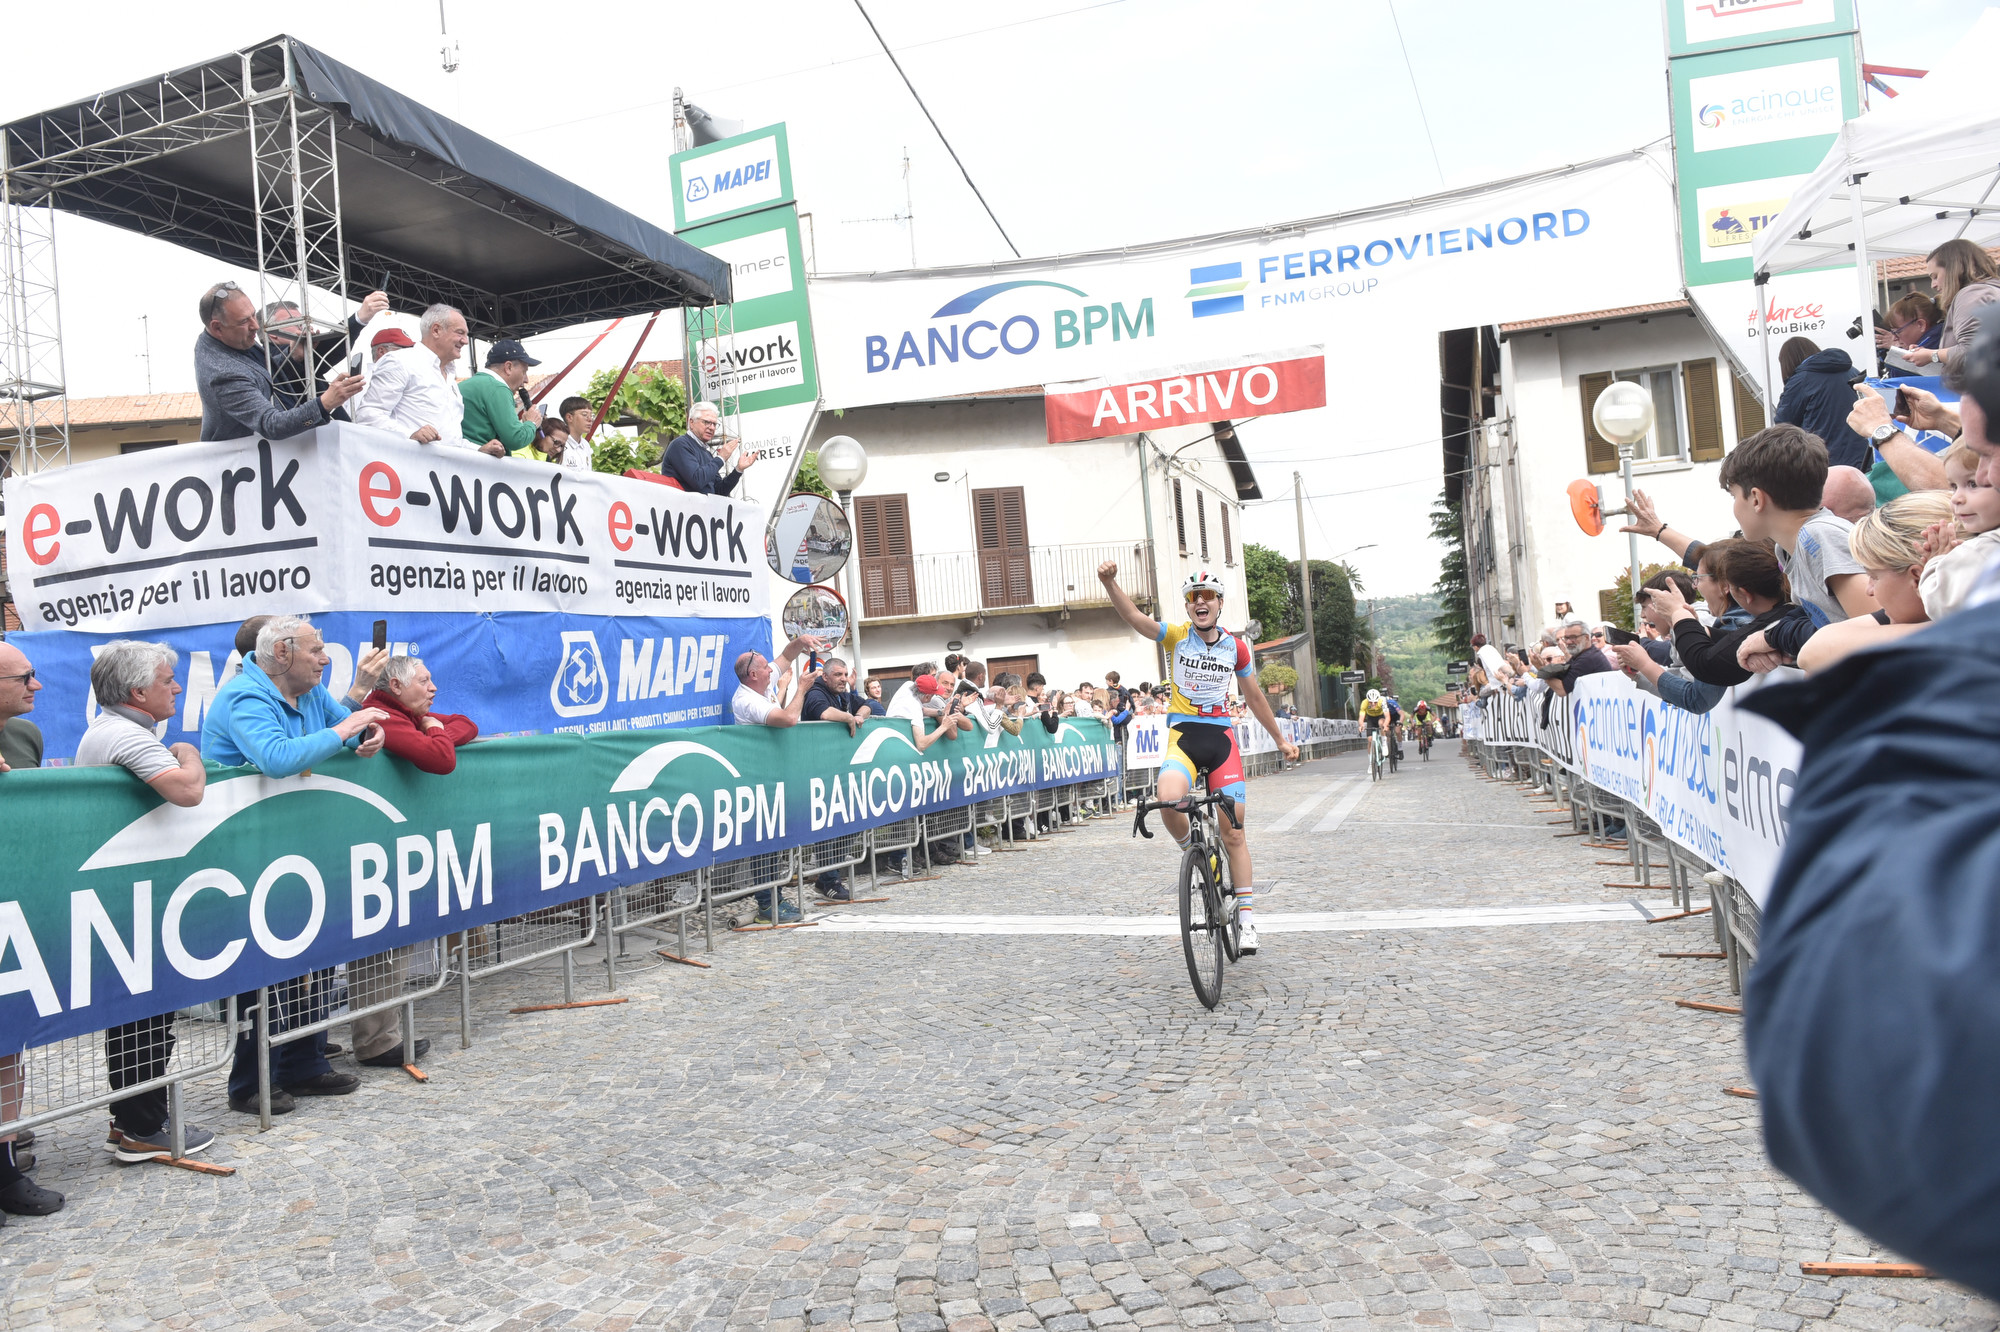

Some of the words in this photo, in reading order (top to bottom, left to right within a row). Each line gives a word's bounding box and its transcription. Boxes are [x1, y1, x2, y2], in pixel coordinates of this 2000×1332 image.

[1731, 85, 1835, 115] acinque
[713, 159, 771, 193] MAPEI
[734, 256, 785, 276] lmec
[1259, 208, 1590, 283] FERROVIENORD
[701, 335, 794, 373] e-work
[866, 315, 1040, 374] BANCO
[1053, 297, 1155, 349] BPM
[742, 373, 757, 384] per
[768, 366, 796, 377] lavoro
[1092, 366, 1279, 427] ARRIVO
[744, 437, 778, 451] OMUNE
[22, 439, 307, 566] e-work
[358, 460, 584, 546] e-work
[607, 500, 748, 564] e-work
[39, 583, 134, 627] agenzia
[138, 580, 182, 614] per
[192, 569, 210, 600] il
[221, 565, 311, 598] lavoro
[370, 560, 466, 597] agenzia
[473, 567, 505, 598] per
[512, 564, 525, 592] il
[531, 564, 588, 596] lavoro
[615, 578, 672, 602] agenzia
[675, 583, 697, 605] per
[700, 581, 710, 602] il
[712, 582, 750, 604] lavoro
[617, 634, 725, 702] MAPEI
[1179, 655, 1200, 669] F.LLI
[1184, 668, 1224, 684] brasilia
[631, 714, 662, 729] PRODOTTI
[664, 710, 687, 723] CHIMICI
[688, 708, 698, 720] PER
[1588, 697, 1638, 761] acinque
[962, 751, 1018, 797] BANCO
[1017, 749, 1036, 785] BPM
[1042, 746, 1080, 782] BANCO
[1079, 744, 1103, 775] BPM
[1724, 731, 1798, 847] elme
[810, 765, 904, 832] BANCO
[910, 758, 953, 809] BPM
[539, 793, 703, 891] BANCO
[712, 781, 786, 852] BPM
[0, 854, 326, 1018] ANCO
[350, 822, 493, 939] BPM
